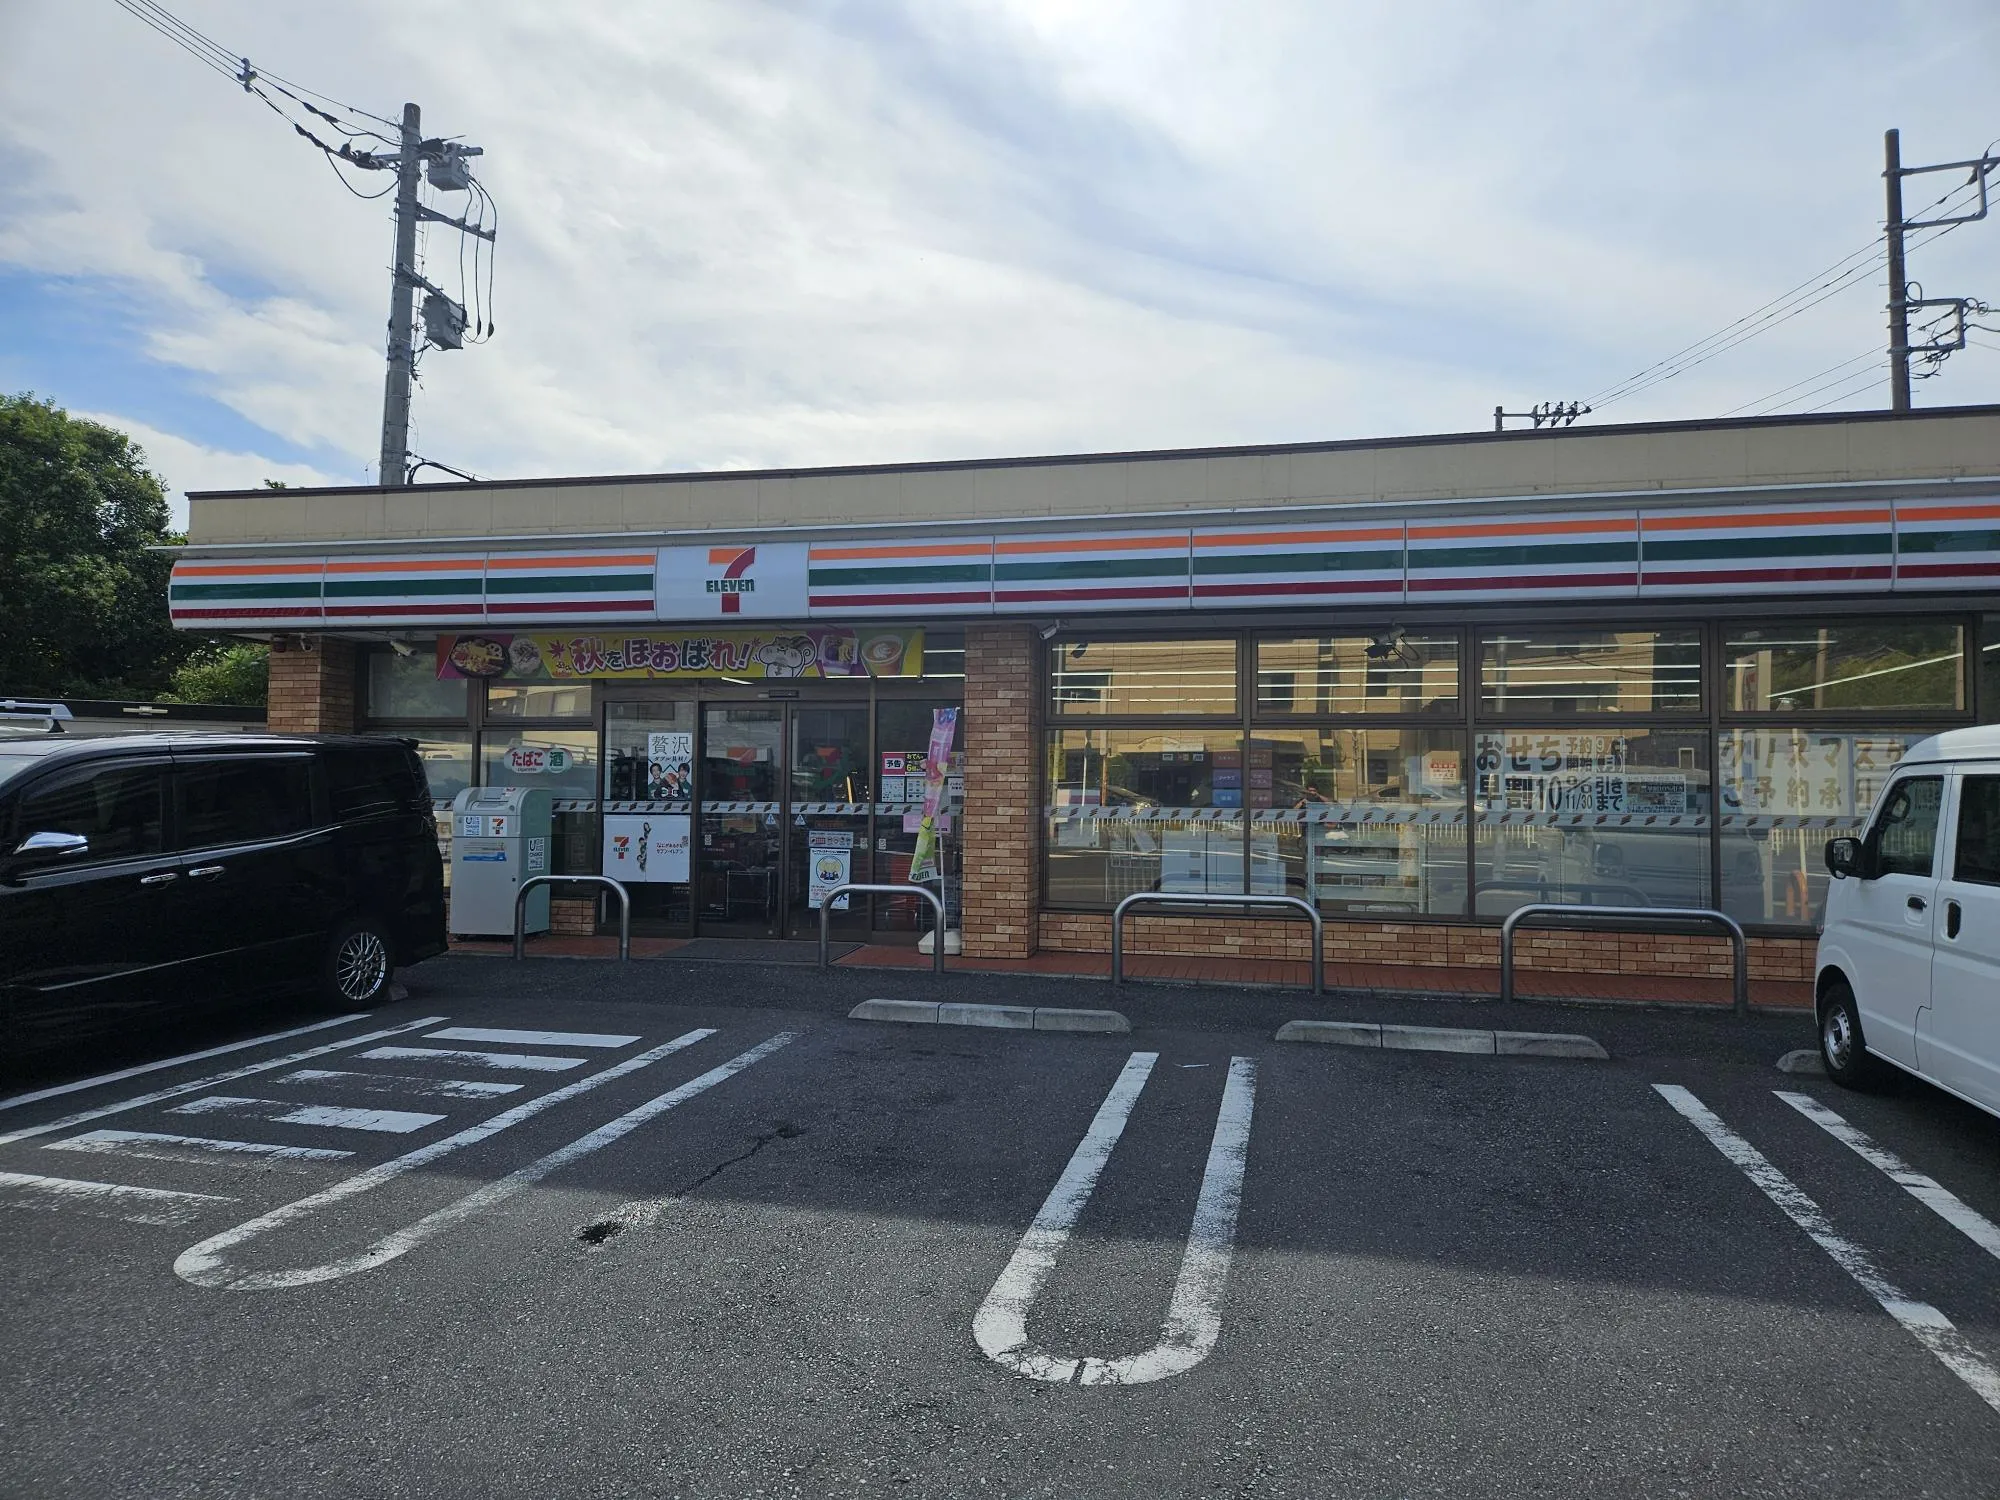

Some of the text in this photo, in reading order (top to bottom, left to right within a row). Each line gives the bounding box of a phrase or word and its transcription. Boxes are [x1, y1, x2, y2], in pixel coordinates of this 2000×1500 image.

[709, 547, 756, 612] 7
[652, 736, 690, 754] 贅沢
[1476, 736, 1563, 771] おせち
[512, 751, 564, 767] たばこ 酒
[886, 760, 901, 768] 予告
[614, 837, 629, 859] 7
